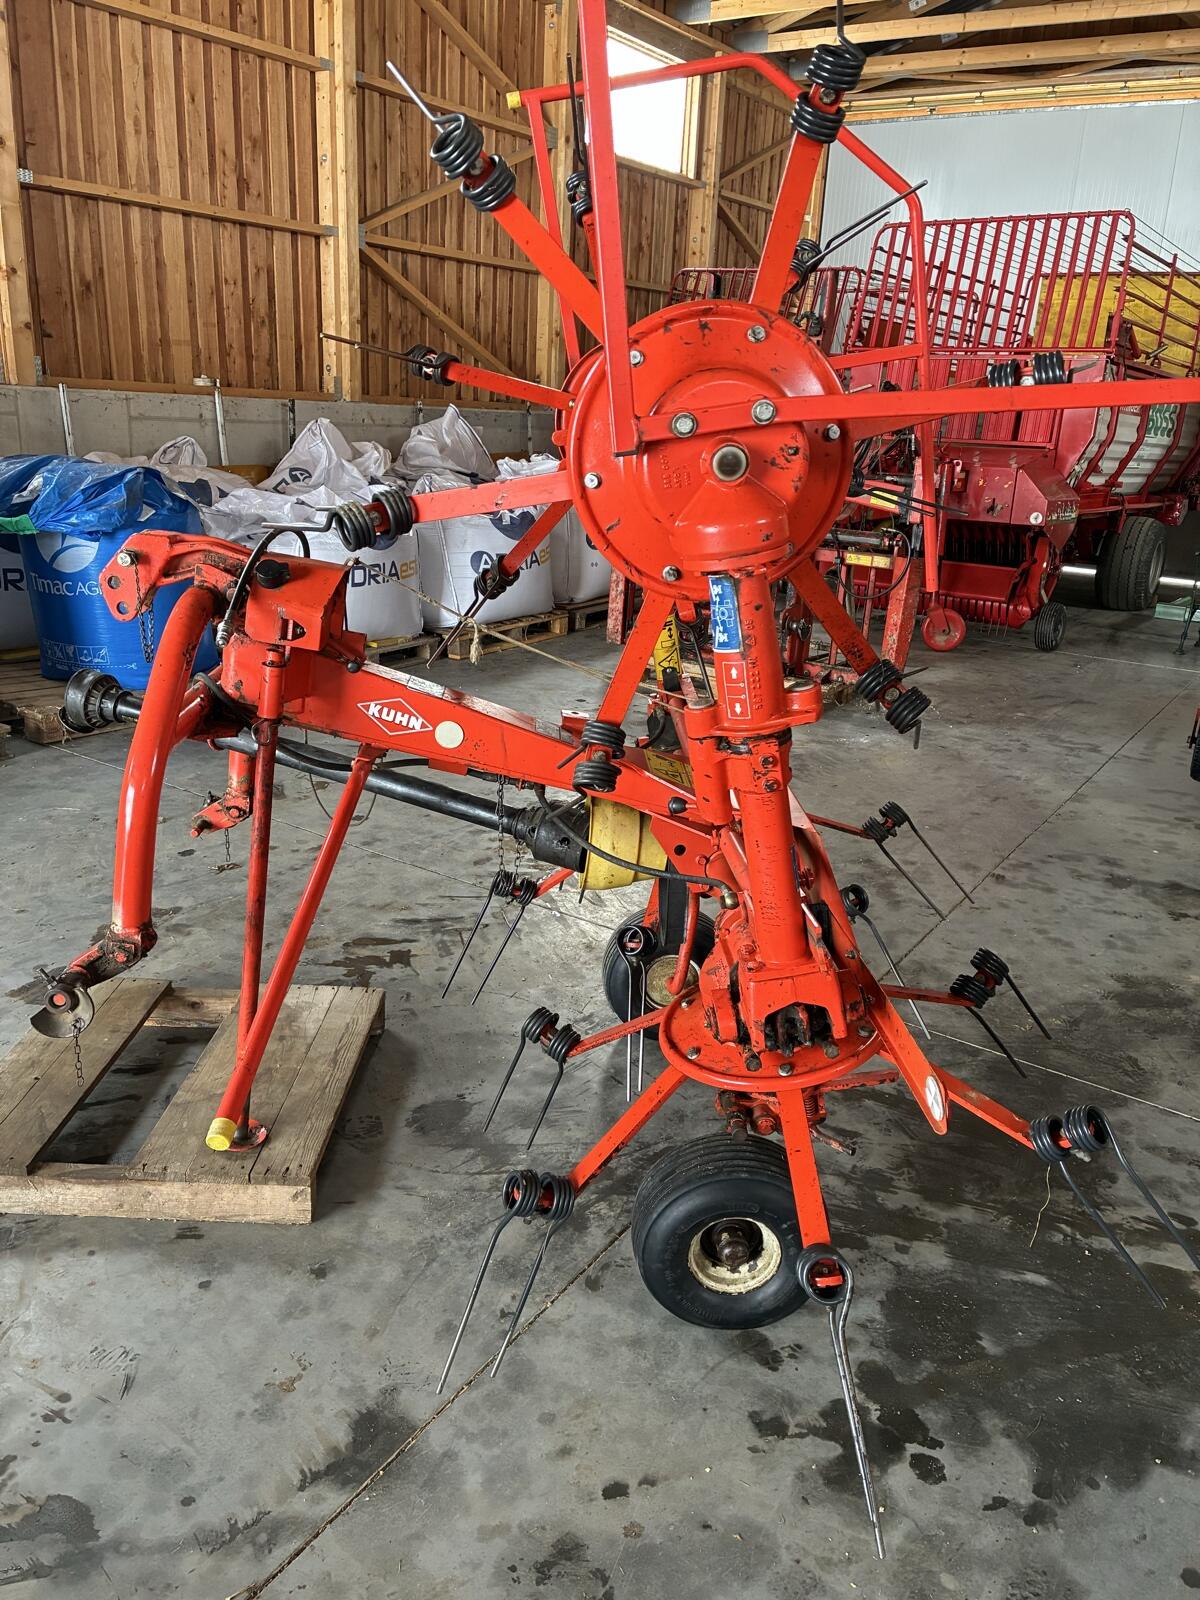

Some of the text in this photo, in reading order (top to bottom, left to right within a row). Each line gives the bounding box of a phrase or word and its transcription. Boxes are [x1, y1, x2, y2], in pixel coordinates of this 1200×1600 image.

[30, 571, 75, 596] Timac
[76, 580, 103, 596] AG
[368, 703, 422, 730] KUHN
